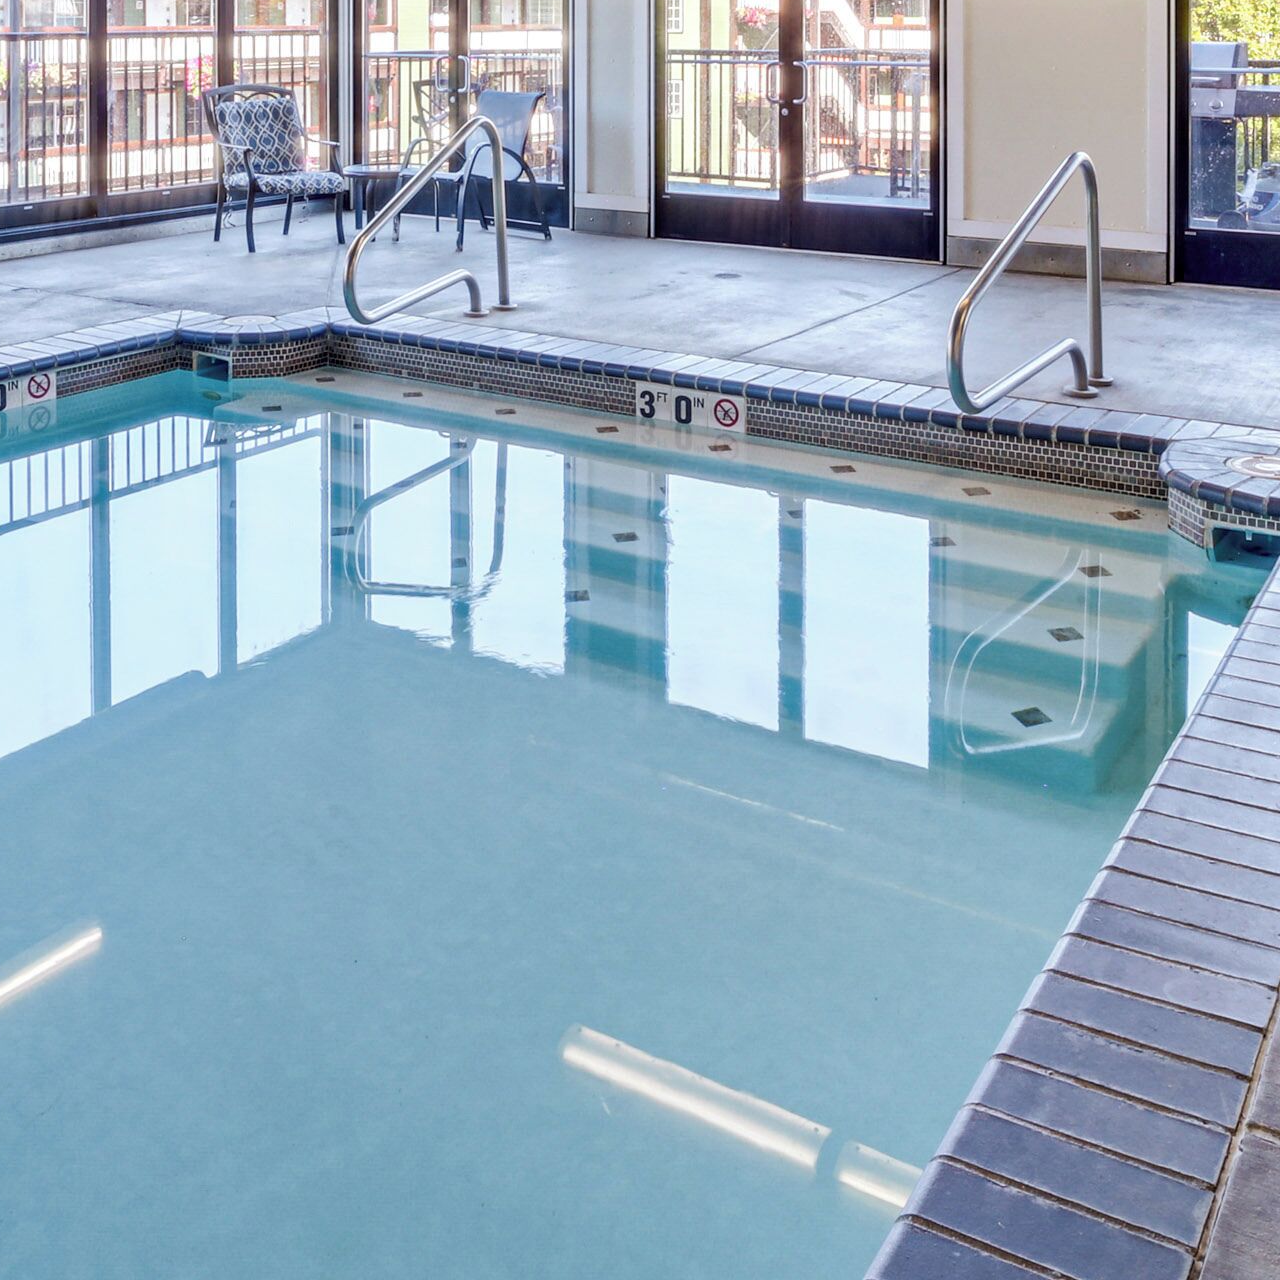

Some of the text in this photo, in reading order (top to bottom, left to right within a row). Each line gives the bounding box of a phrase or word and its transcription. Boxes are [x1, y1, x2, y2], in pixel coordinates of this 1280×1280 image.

[8, 380, 18, 391] IN
[640, 390, 705, 424] 3 FT 0 IN
